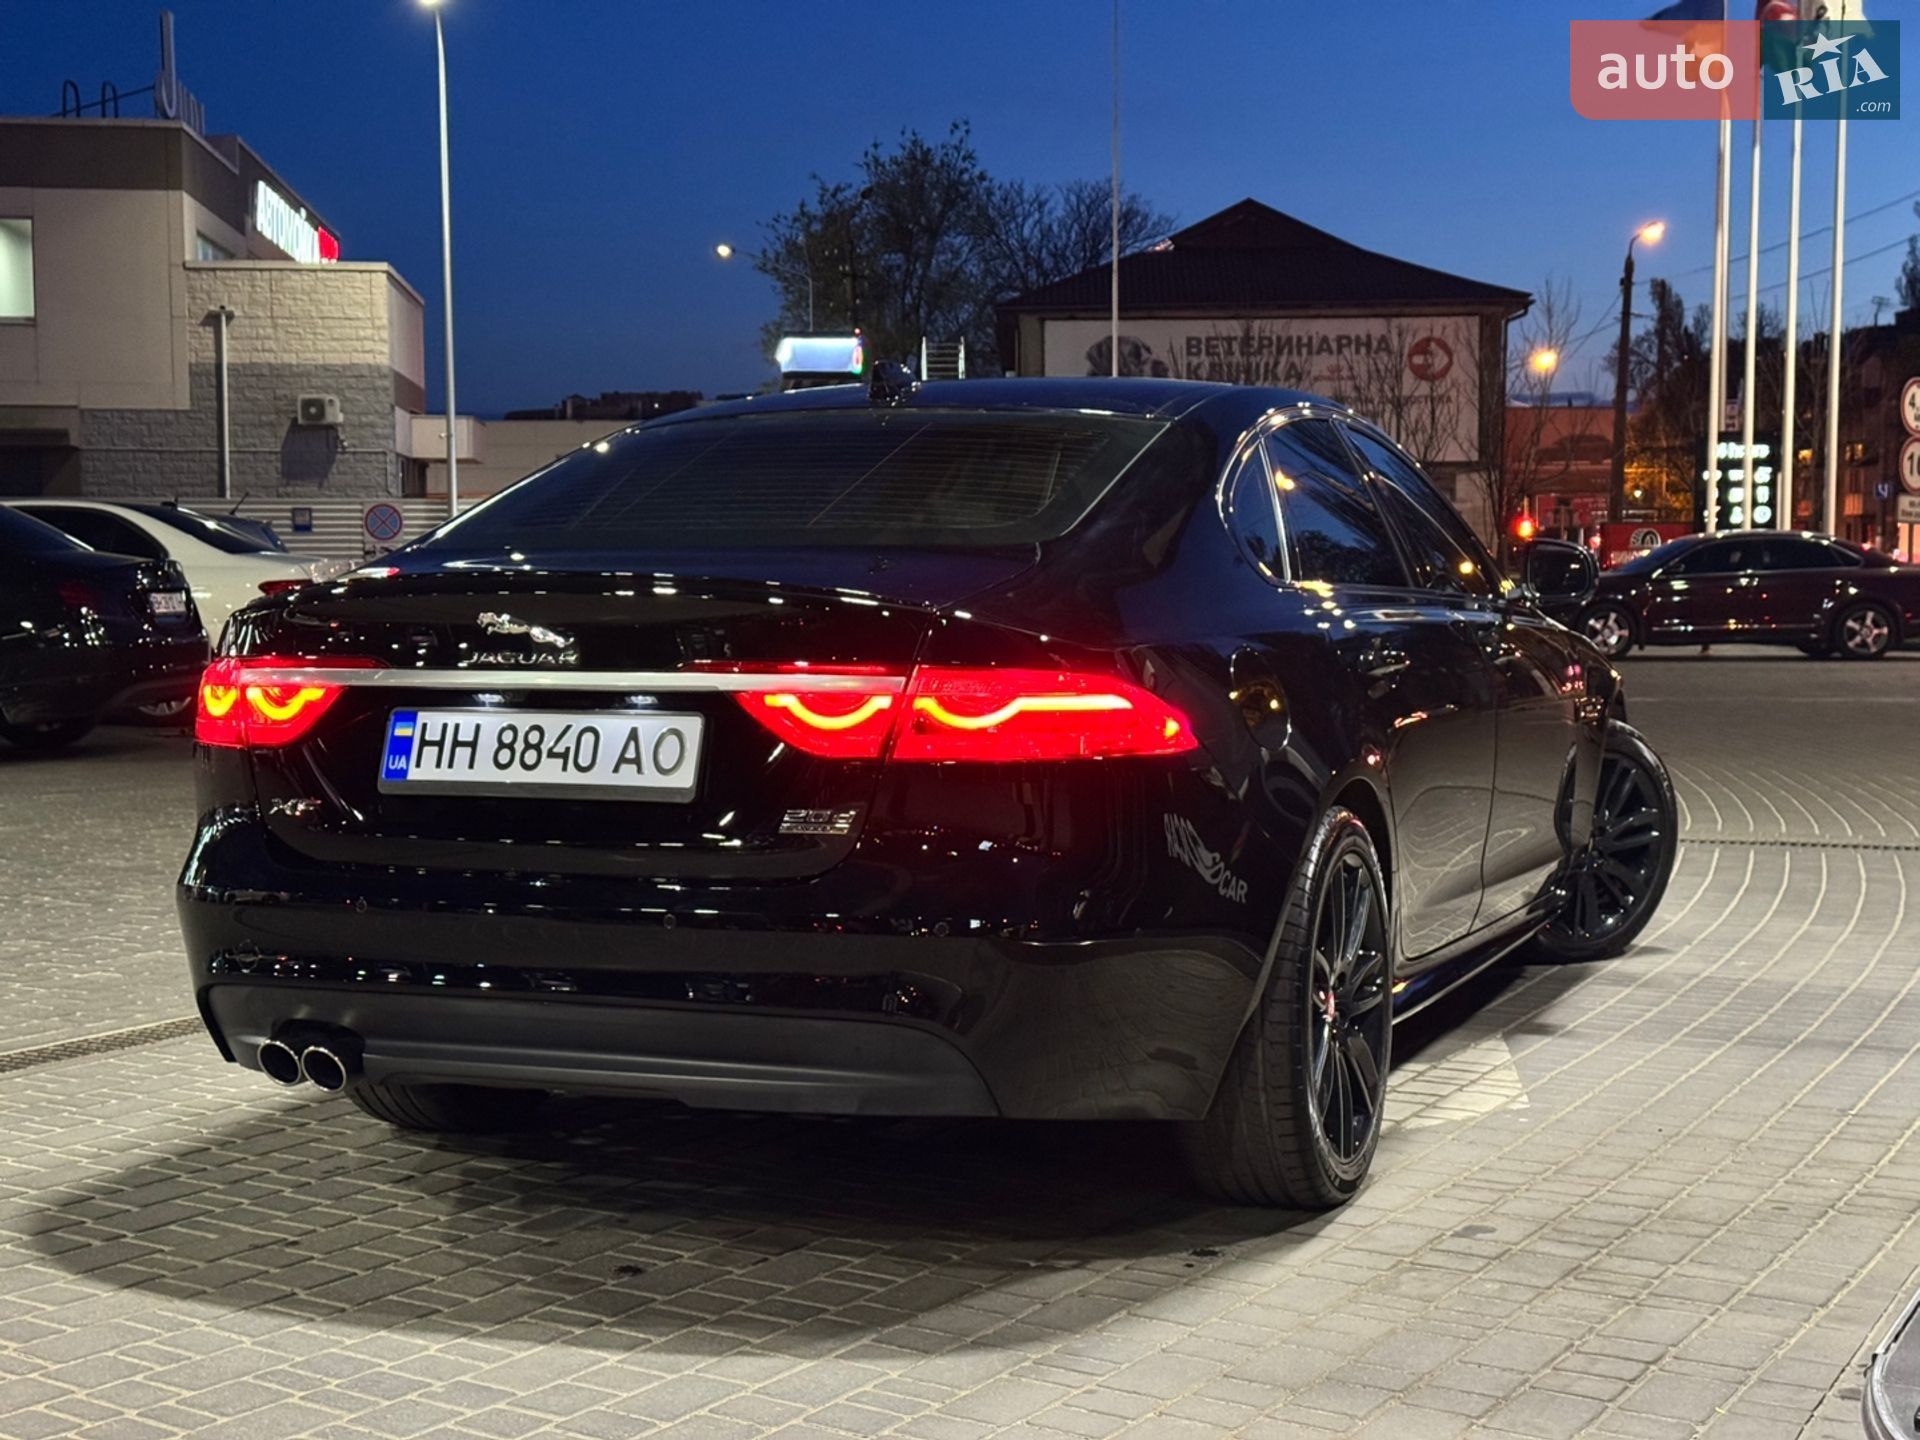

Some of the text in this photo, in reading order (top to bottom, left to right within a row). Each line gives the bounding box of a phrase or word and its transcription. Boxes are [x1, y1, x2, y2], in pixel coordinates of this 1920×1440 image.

[1185, 335, 1393, 357] ВЕТЕРИНАРНА
[463, 650, 579, 666] JAGUAR
[414, 722, 688, 777] HH 8840 AO
[388, 754, 407, 771] UA
